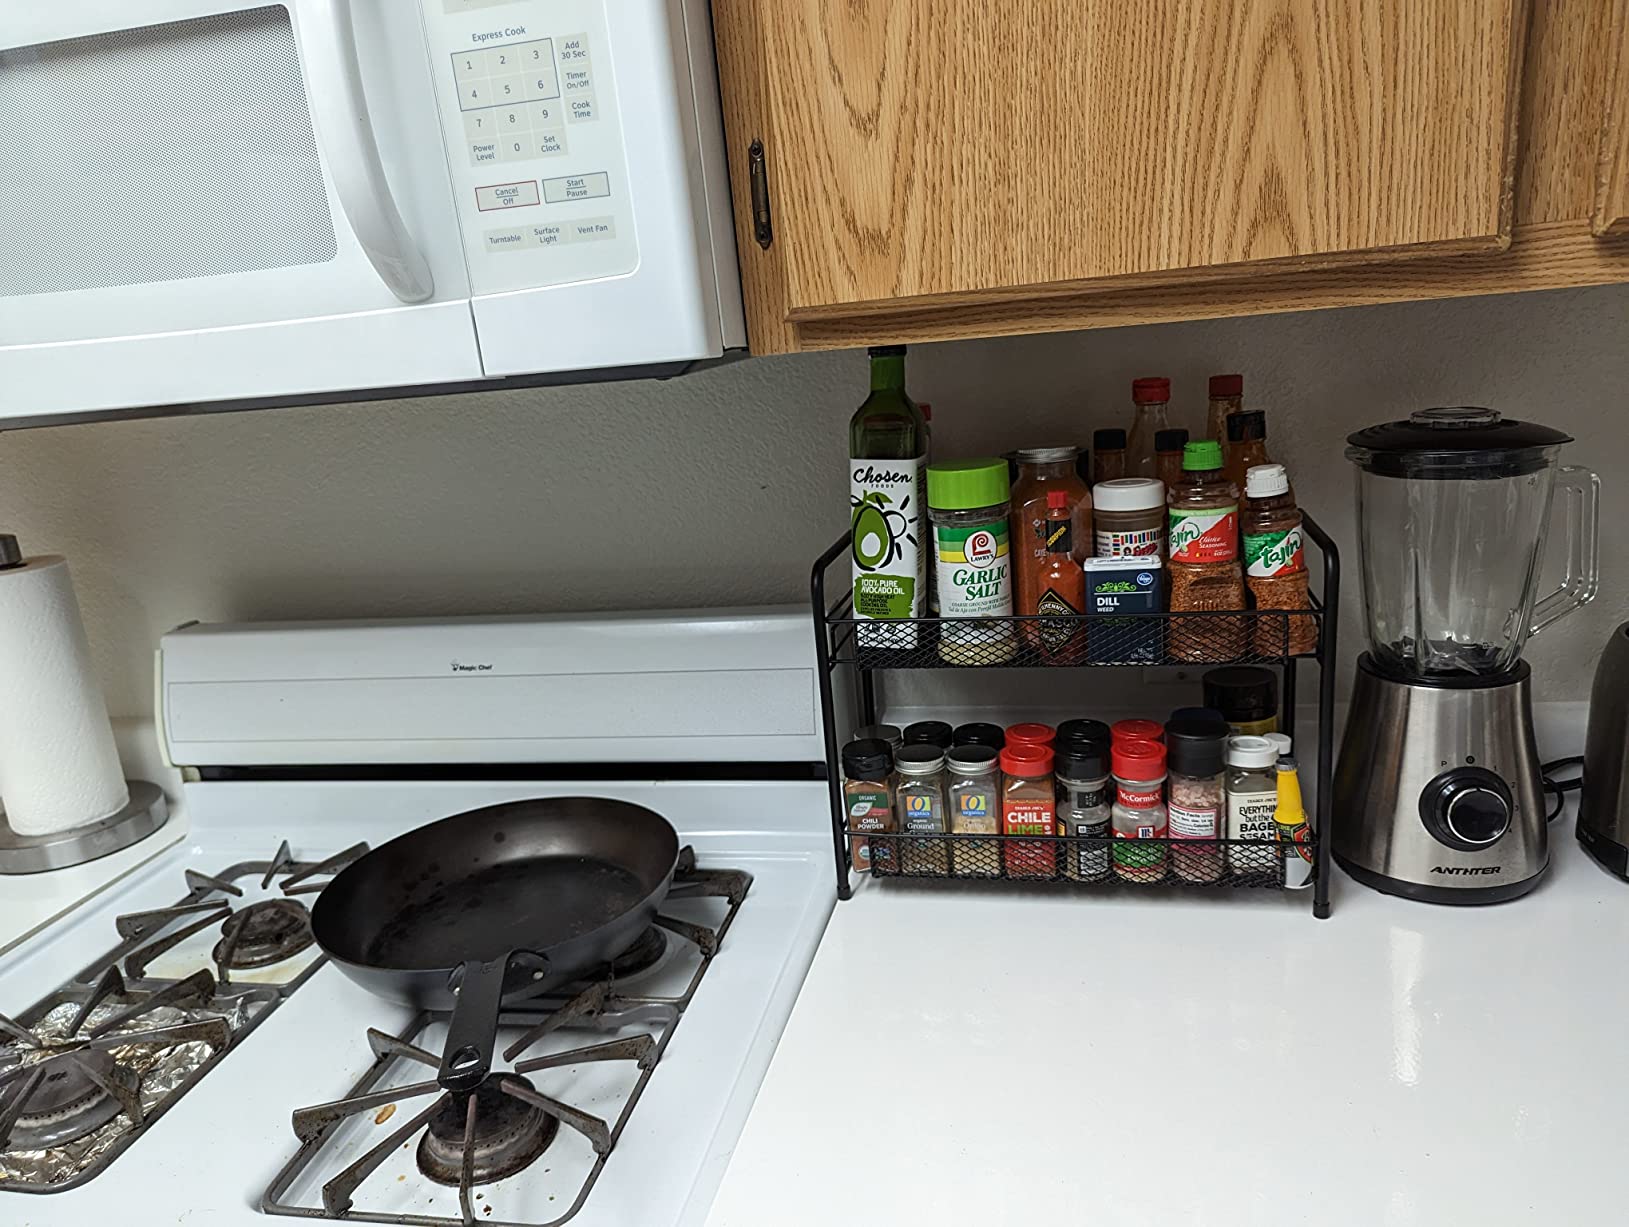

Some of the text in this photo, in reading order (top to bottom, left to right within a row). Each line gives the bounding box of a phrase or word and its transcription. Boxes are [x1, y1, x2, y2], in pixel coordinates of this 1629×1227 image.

[472, 26, 526, 42] Express Cook
[565, 41, 580, 50] Add
[562, 49, 586, 60] 30 Sec
[466, 50, 540, 70] 1 2 3
[566, 71, 586, 80] Timer
[472, 80, 544, 98] 4 5 6
[566, 80, 590, 90] On/Off
[572, 100, 590, 110] Cook
[476, 110, 548, 128] 7 8 9
[574, 110, 591, 118] Time
[544, 136, 556, 144] Set
[473, 144, 494, 153] Power
[540, 143, 560, 152] Clock
[476, 152, 495, 160] Level
[566, 178, 584, 187] Start
[495, 187, 519, 196] Cancel
[566, 189, 588, 198] Pause
[502, 198, 514, 206] Off
[534, 226, 560, 236] Surface
[578, 224, 608, 234] Vent Fan
[489, 234, 522, 244] Turntable
[540, 235, 557, 244] Light
[853, 466, 911, 484] Chosen
[953, 564, 1008, 586] GARLIC
[880, 580, 898, 588] PURE
[966, 581, 1002, 601] SALT
[1097, 597, 1120, 606] DILL
[1120, 791, 1160, 802] McCormick
[1239, 804, 1277, 815] EVERYTHIN
[1007, 812, 1051, 823] CHILE
[1008, 824, 1042, 834] LIME
[1240, 822, 1274, 832] BAGE
[1430, 866, 1501, 875] ANTHTER
